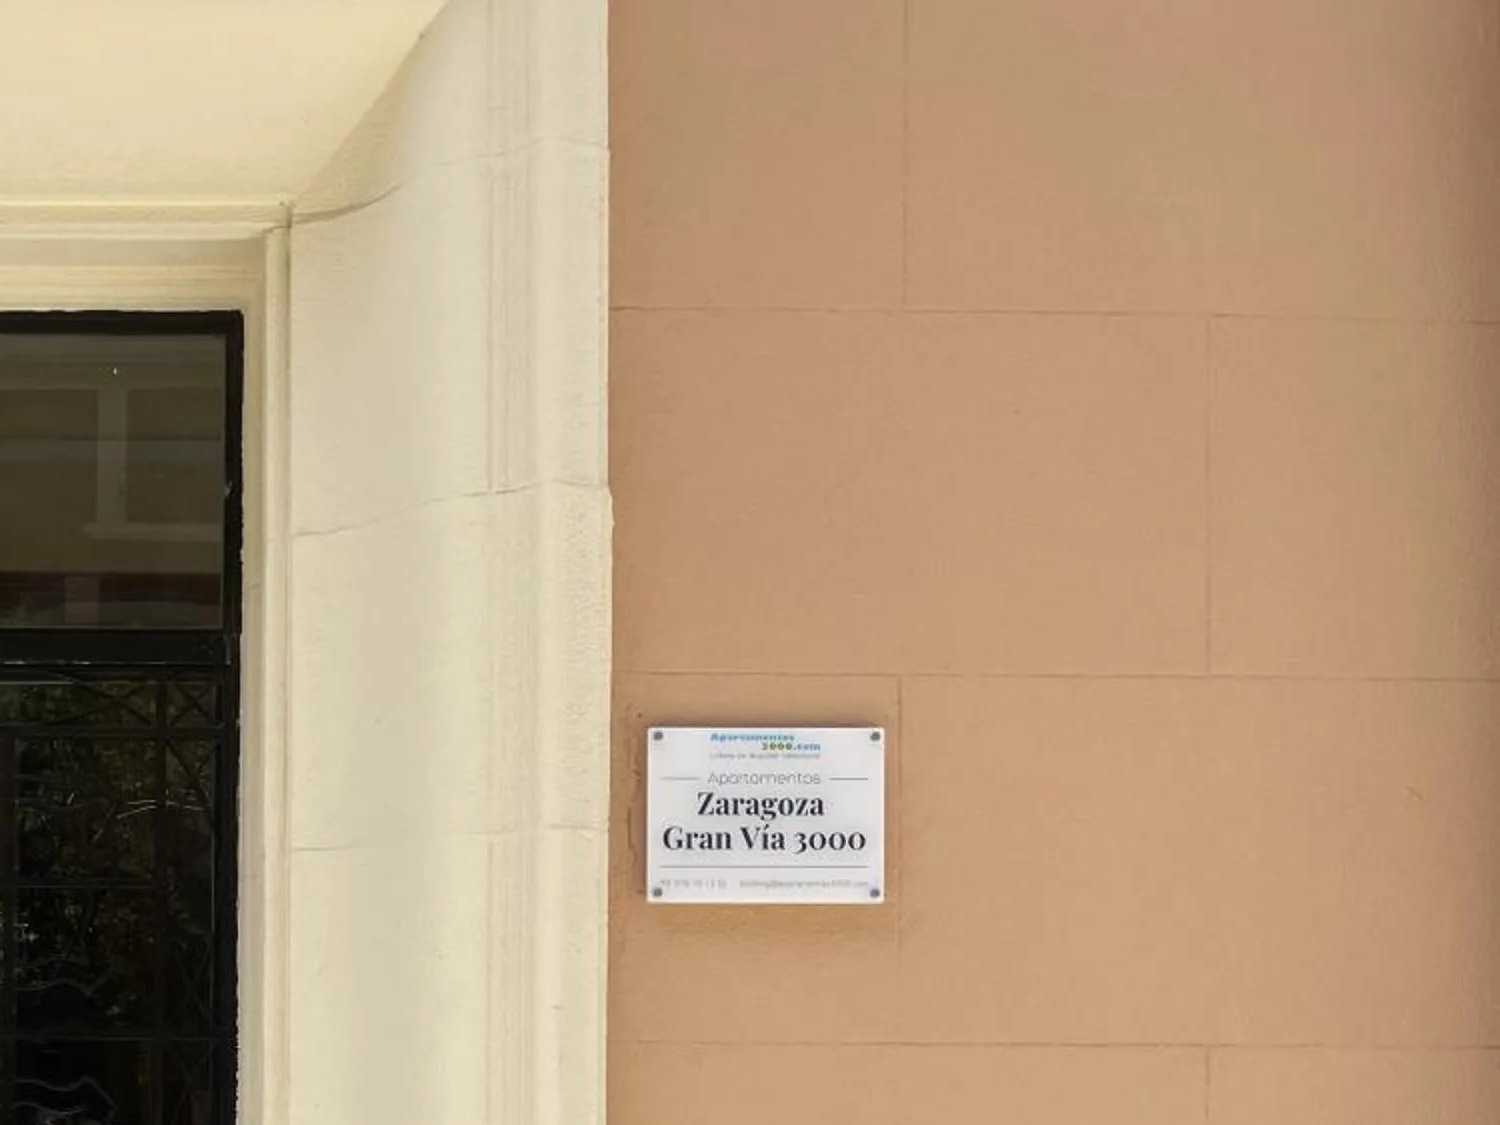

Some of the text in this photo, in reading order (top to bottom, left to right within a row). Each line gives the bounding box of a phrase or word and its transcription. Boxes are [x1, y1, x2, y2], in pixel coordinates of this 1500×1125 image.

[707, 771, 821, 785] Apartamentos
[697, 792, 824, 820] Zaragoza
[663, 824, 866, 854] Gran Vía 3000
